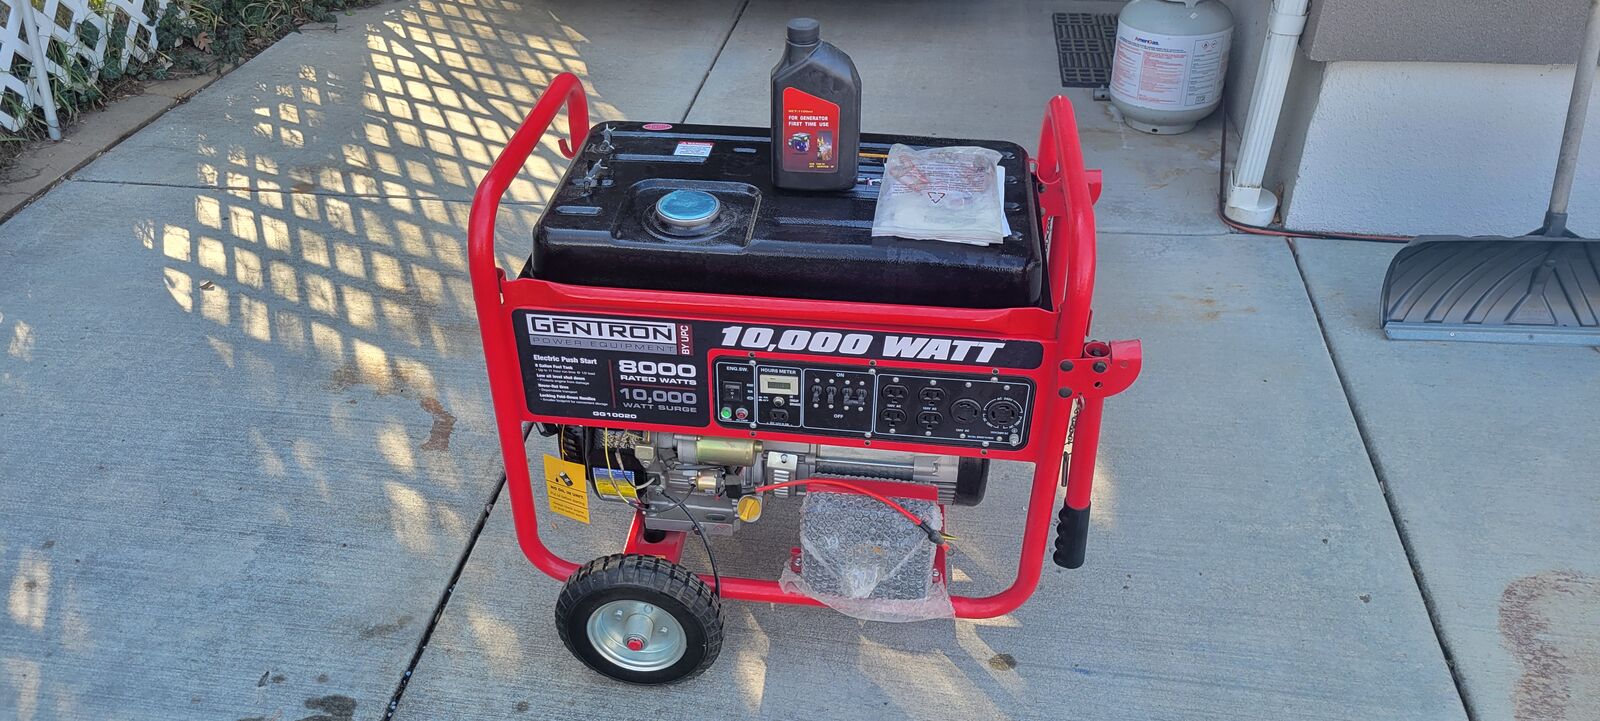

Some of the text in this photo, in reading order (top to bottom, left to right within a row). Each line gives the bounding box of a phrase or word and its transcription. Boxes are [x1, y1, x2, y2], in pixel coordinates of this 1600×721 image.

[531, 316, 672, 341] GENTRON
[532, 337, 675, 352] POWER EQUIPMENT
[681, 325, 690, 354] BY UPC
[721, 326, 1006, 362] 10,000 WATT
[618, 360, 696, 378] 8000
[659, 378, 697, 386] WATTS
[620, 388, 697, 404] 10,000
